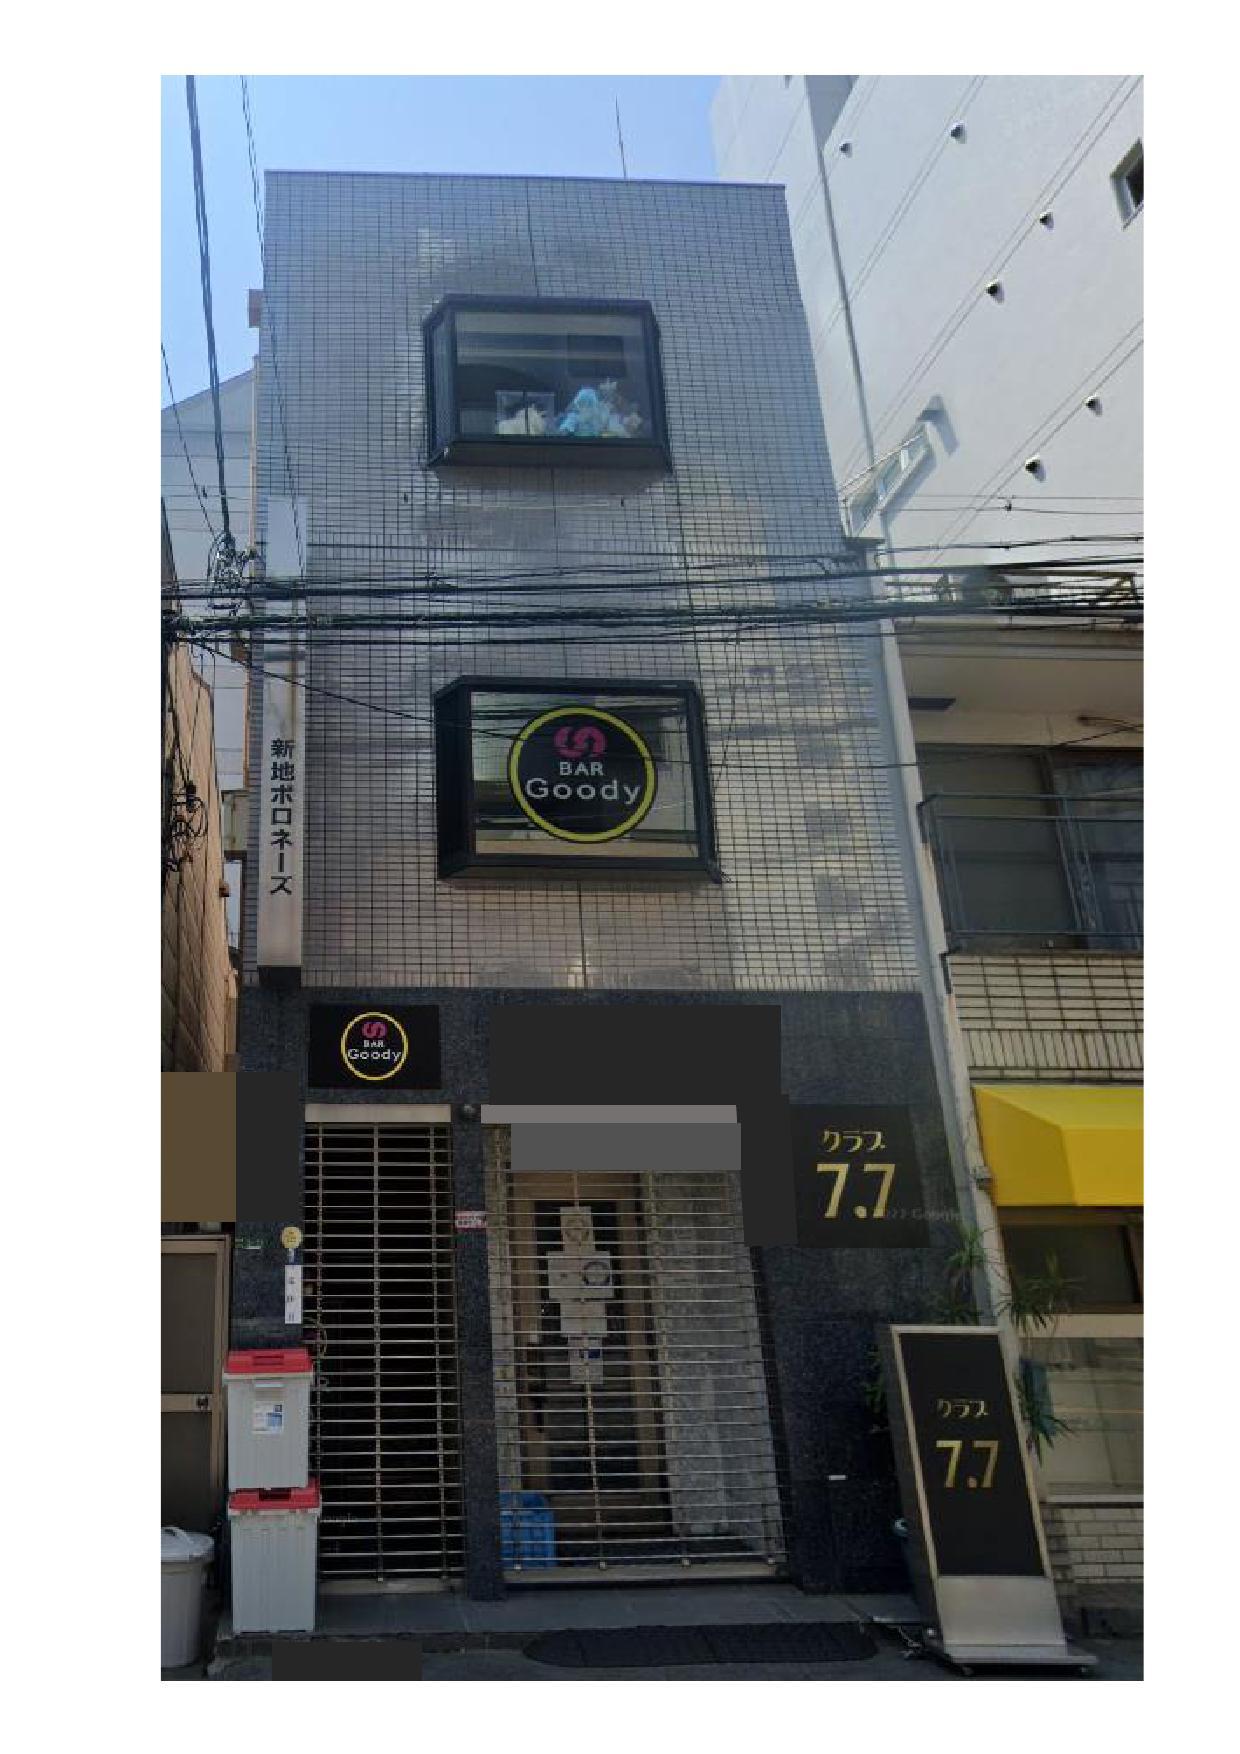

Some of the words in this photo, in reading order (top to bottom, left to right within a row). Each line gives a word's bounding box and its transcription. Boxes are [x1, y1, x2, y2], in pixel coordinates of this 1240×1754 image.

[559, 761, 604, 776] BAR
[526, 777, 641, 805] Goody
[363, 1039, 385, 1048] BAR
[347, 1048, 402, 1063] Goody
[816, 1163, 896, 1219] 7.7
[935, 1440, 999, 1489] 7.7
